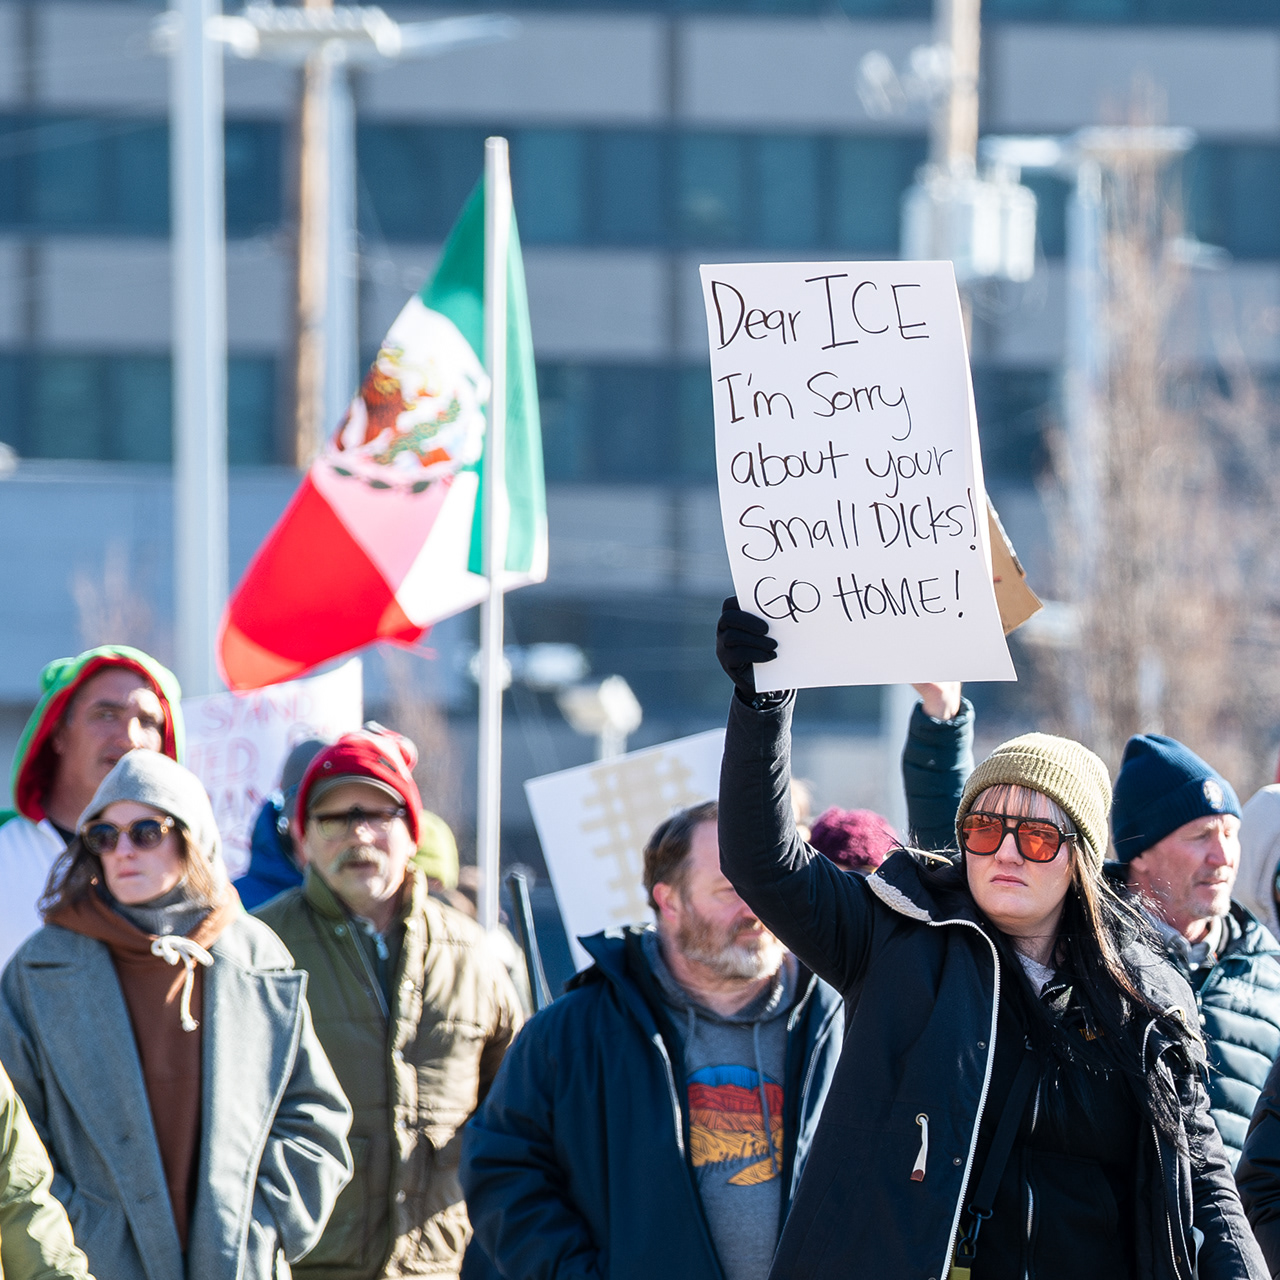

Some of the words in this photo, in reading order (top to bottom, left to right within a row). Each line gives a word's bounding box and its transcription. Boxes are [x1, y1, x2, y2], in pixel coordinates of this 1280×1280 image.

[711, 280, 801, 350] Dear
[804, 273, 930, 351] ICE
[717, 372, 795, 424] I'm
[806, 371, 912, 441] Sorry
[730, 440, 849, 488] about
[865, 446, 953, 498] your
[738, 499, 859, 562] Small
[754, 576, 821, 623] GO
[833, 569, 964, 623] HOME!
